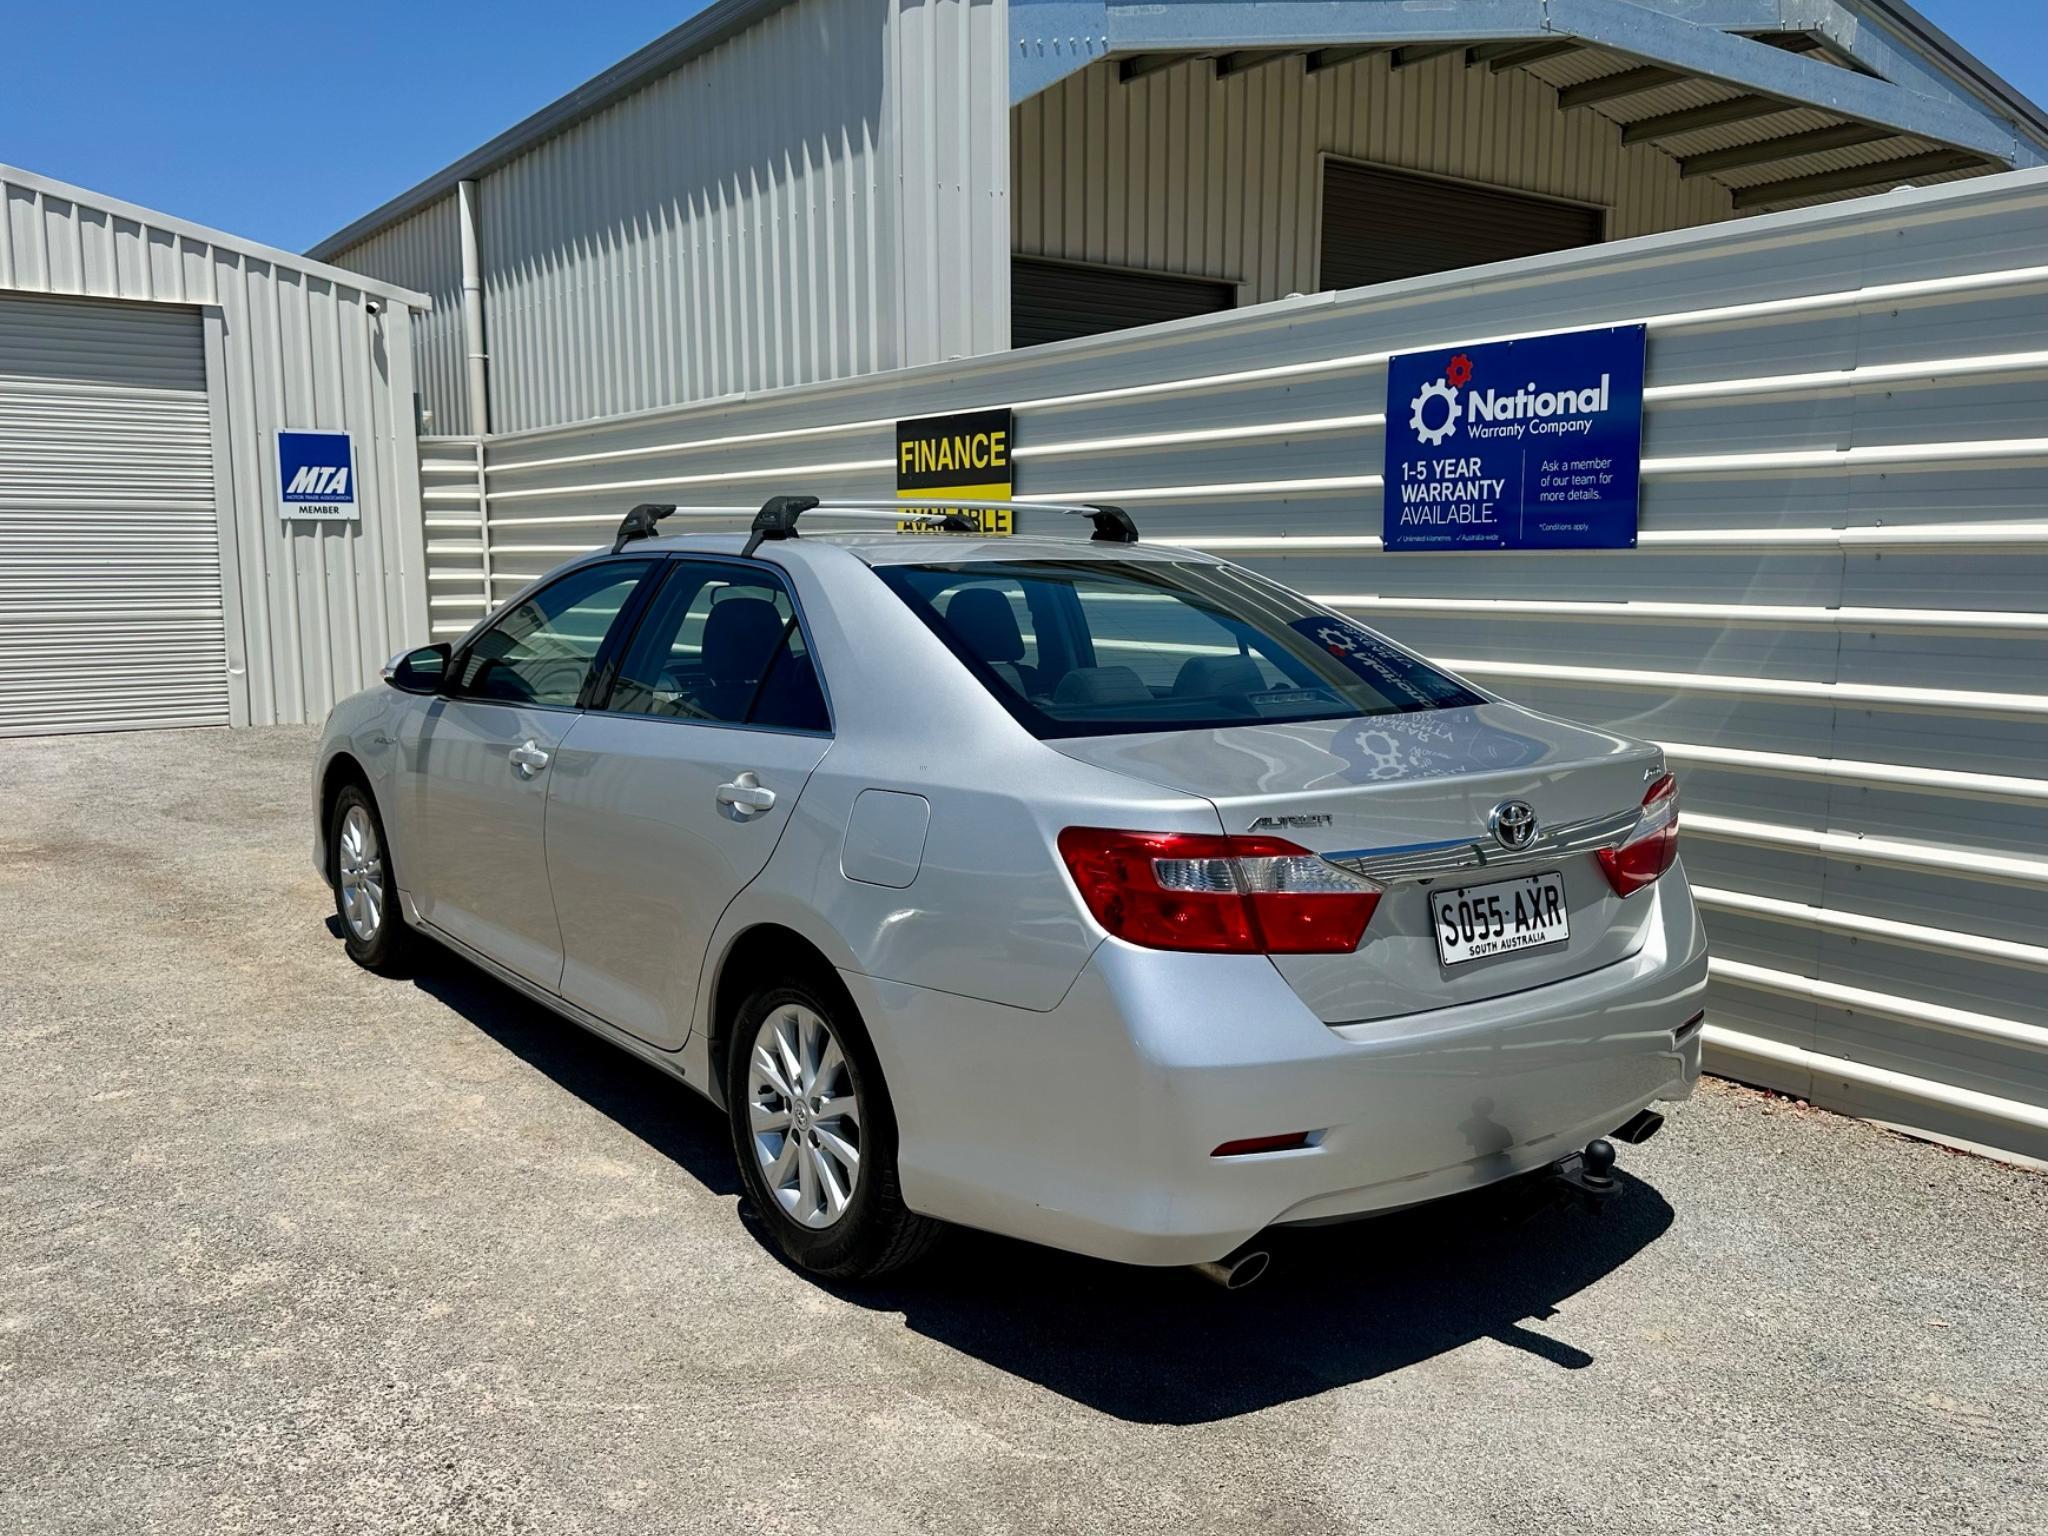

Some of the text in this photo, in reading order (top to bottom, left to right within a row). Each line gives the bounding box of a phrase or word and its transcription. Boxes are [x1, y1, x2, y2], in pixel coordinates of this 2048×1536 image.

[1468, 373, 1610, 423] National
[1467, 419, 1593, 440] Warranty Company
[901, 431, 1006, 474] FINANCE
[1402, 457, 1482, 481] 1-5 YEAR
[1541, 457, 1612, 472] Ask a member
[286, 466, 349, 494] MTA
[1540, 472, 1613, 487] of our team for
[1401, 479, 1505, 504] WARRANTY
[1540, 488, 1602, 502] more details.
[299, 505, 340, 515] MEMBER
[1400, 503, 1498, 526] AVAILABLE.
[1468, 931, 1546, 957] SOUTH AUSTRALIA
